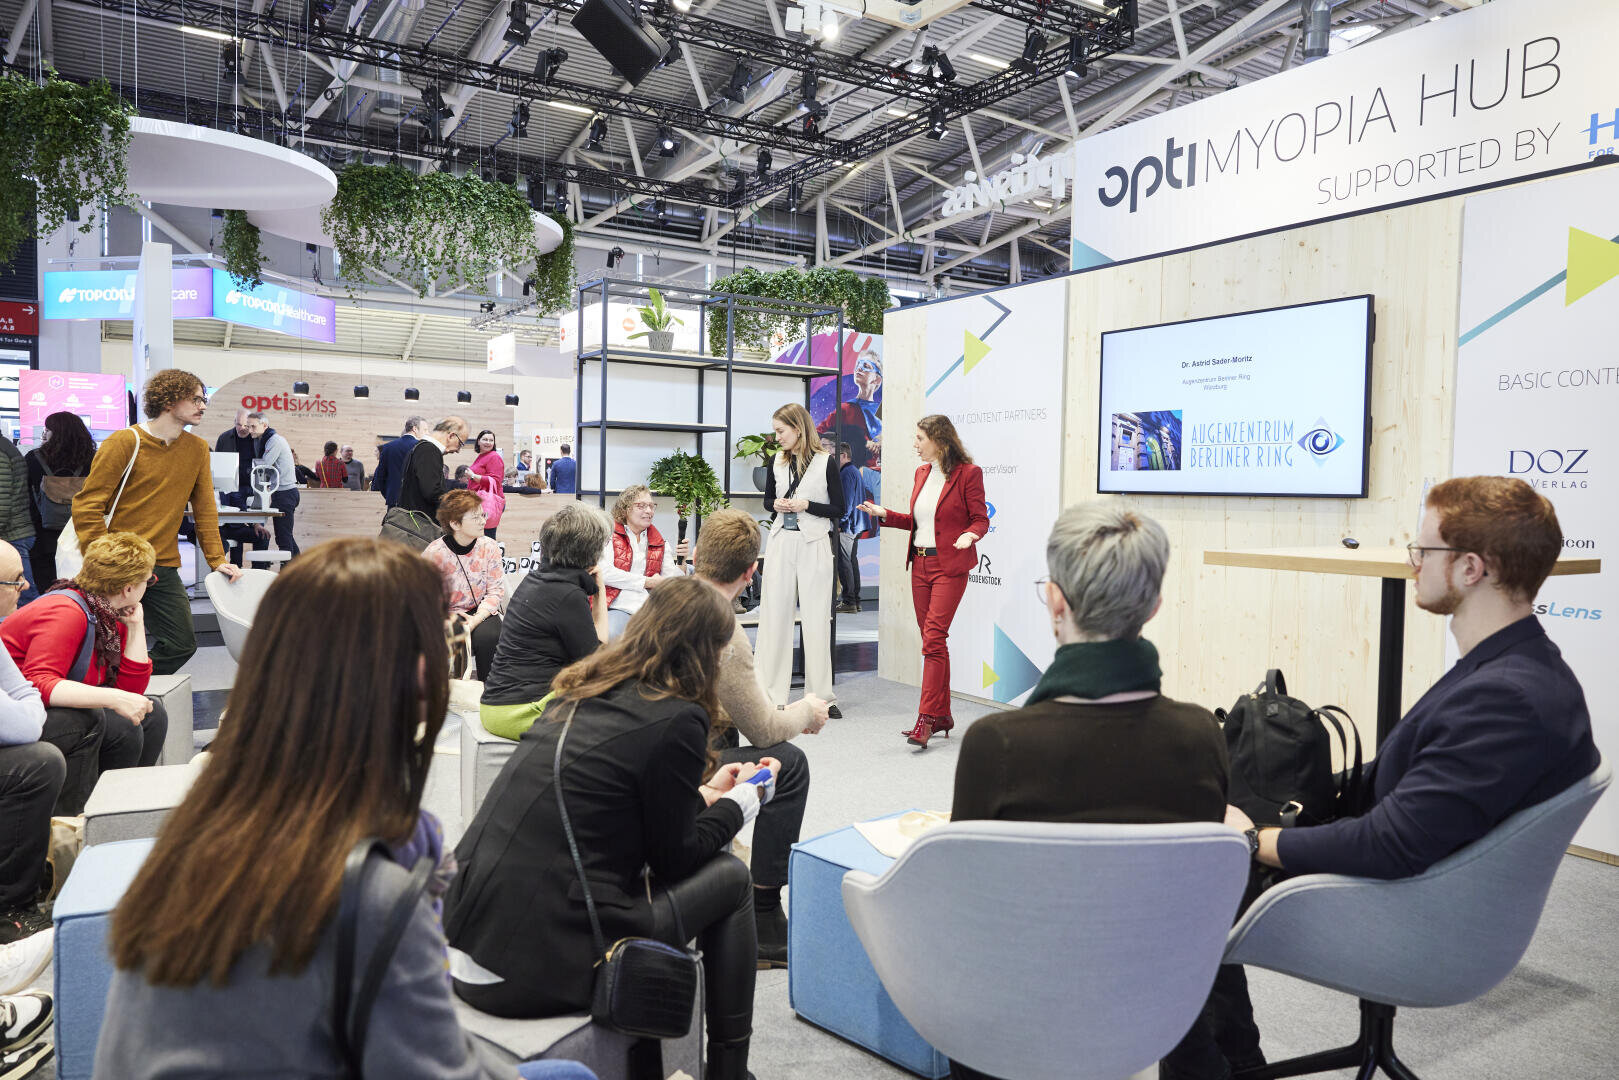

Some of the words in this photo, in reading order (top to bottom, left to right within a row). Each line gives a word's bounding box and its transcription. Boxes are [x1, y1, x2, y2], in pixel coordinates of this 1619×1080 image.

[1097, 137, 1197, 213] opti
[1205, 87, 1396, 183] MYOPIA
[1420, 36, 1561, 126] HUB
[1317, 138, 1501, 204] SUPPORTED
[1515, 122, 1561, 161] BY
[1192, 359, 1211, 367] Astrid
[1212, 355, 1253, 366] Sader-Moritz
[1498, 371, 1552, 391] BASIC
[241, 392, 337, 413] optiswiss
[967, 411, 1002, 424] CONTENT
[1005, 407, 1047, 423] PARTNERS
[1191, 419, 1294, 444] AUGENZENTRUM
[1190, 446, 1250, 468] BERLINER
[1257, 444, 1294, 468] RING
[1508, 449, 1589, 474] DOZ
[1530, 478, 1588, 489] VERLAG
[1560, 535, 1595, 549] icon
[968, 573, 1002, 586] RODENSTOCK
[1531, 601, 1603, 620] sLens
